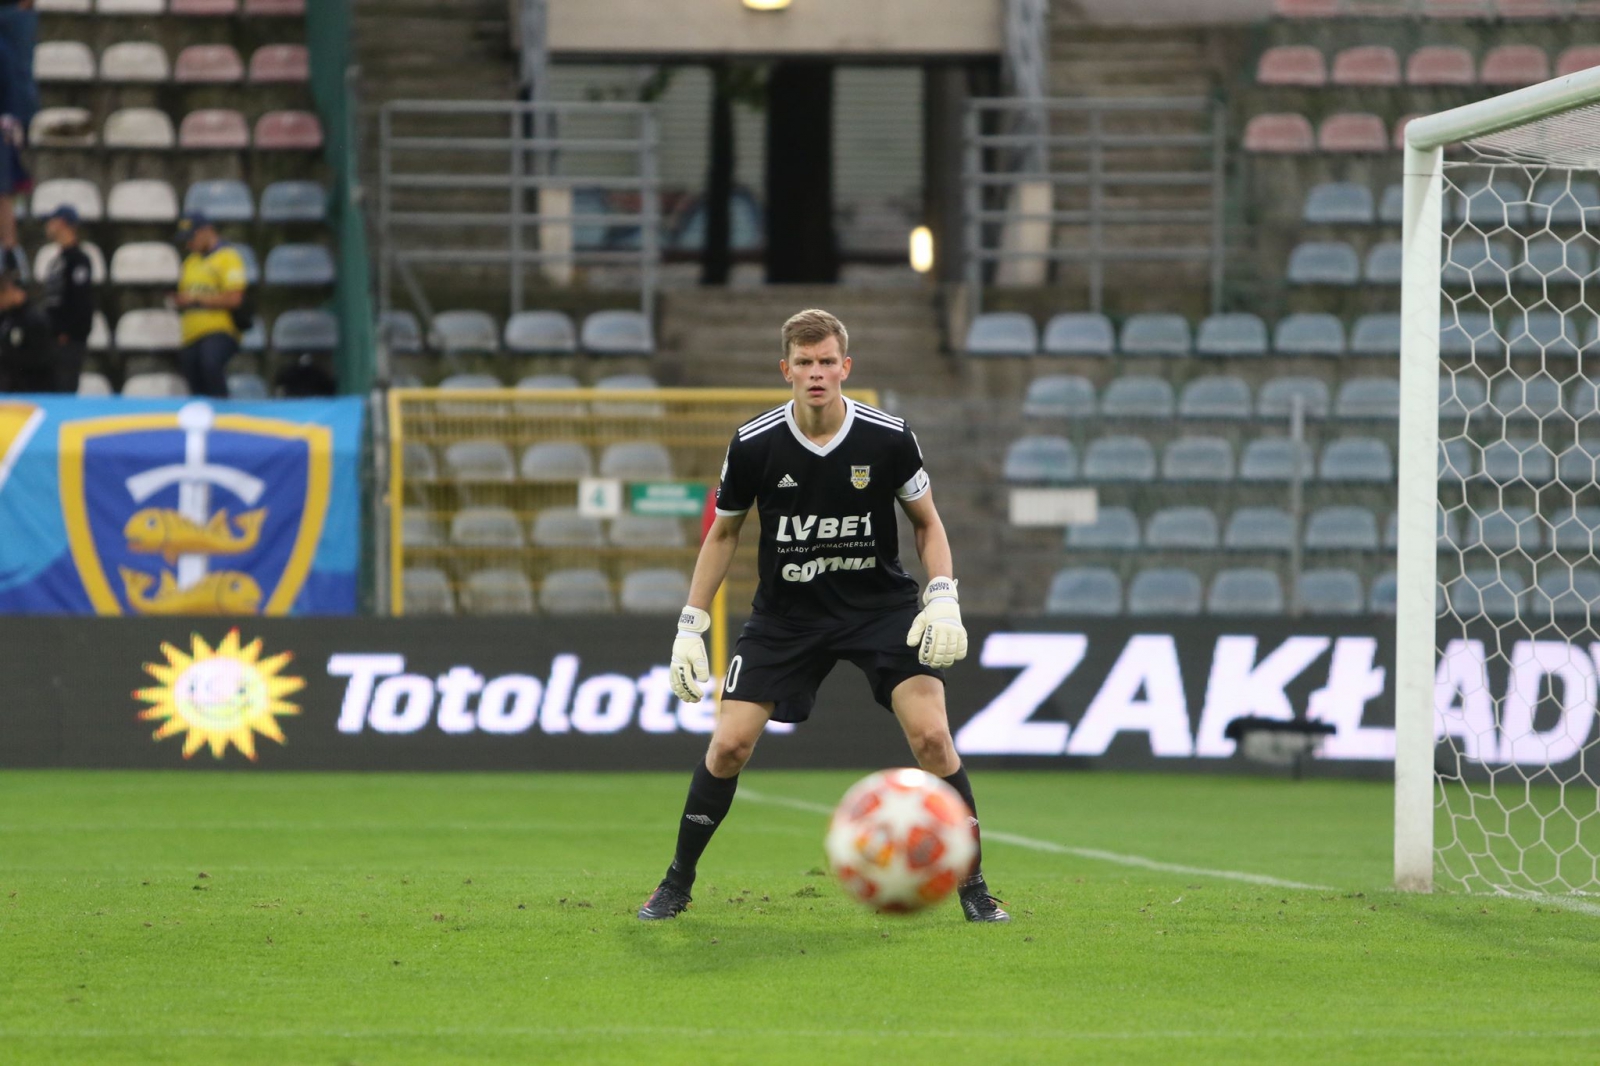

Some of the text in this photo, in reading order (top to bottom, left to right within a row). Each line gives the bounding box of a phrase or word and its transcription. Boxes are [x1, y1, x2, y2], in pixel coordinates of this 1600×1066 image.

[781, 556, 876, 583] GDYNIA
[327, 653, 794, 734] Totolote
[954, 632, 1600, 764] ZAKŁAD
